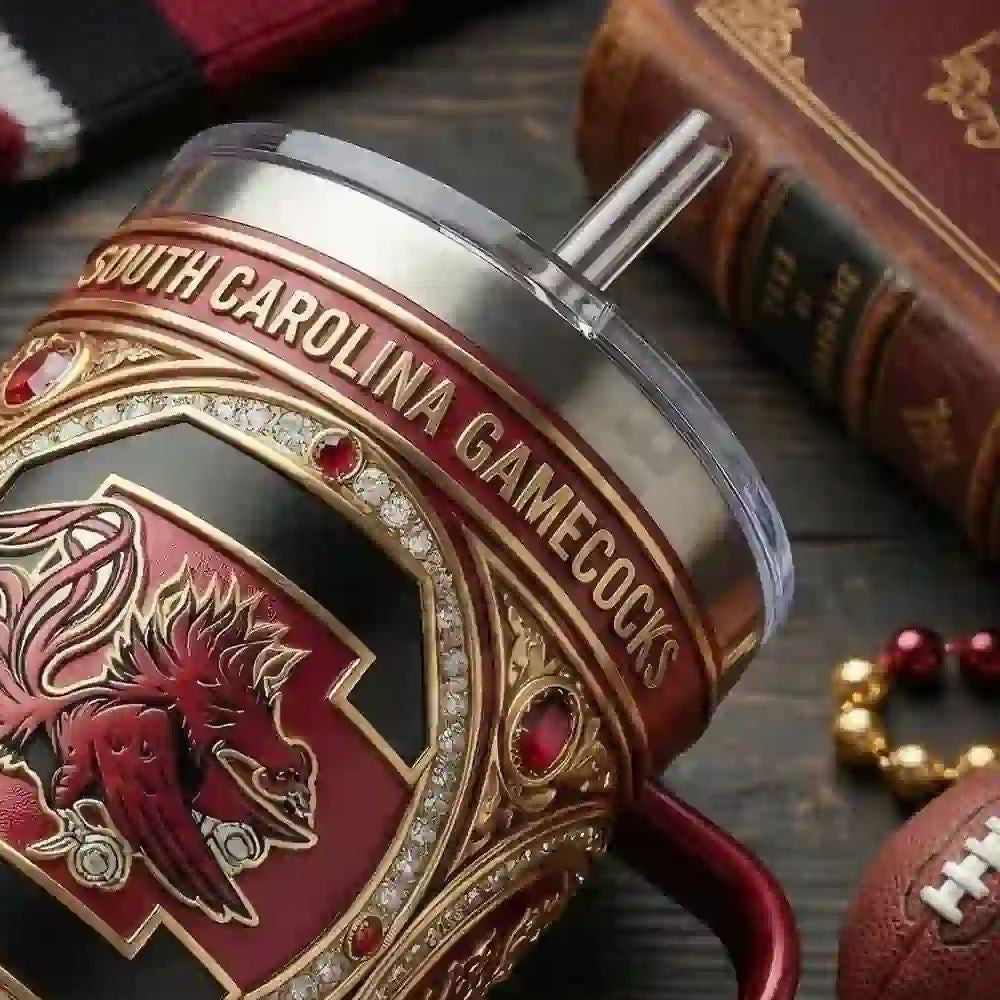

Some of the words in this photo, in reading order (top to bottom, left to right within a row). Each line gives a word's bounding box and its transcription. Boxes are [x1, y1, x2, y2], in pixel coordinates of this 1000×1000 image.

[78, 244, 221, 301] SOUTH
[210, 264, 456, 435] CAROLINA
[455, 411, 679, 688] GAMECOCKS
